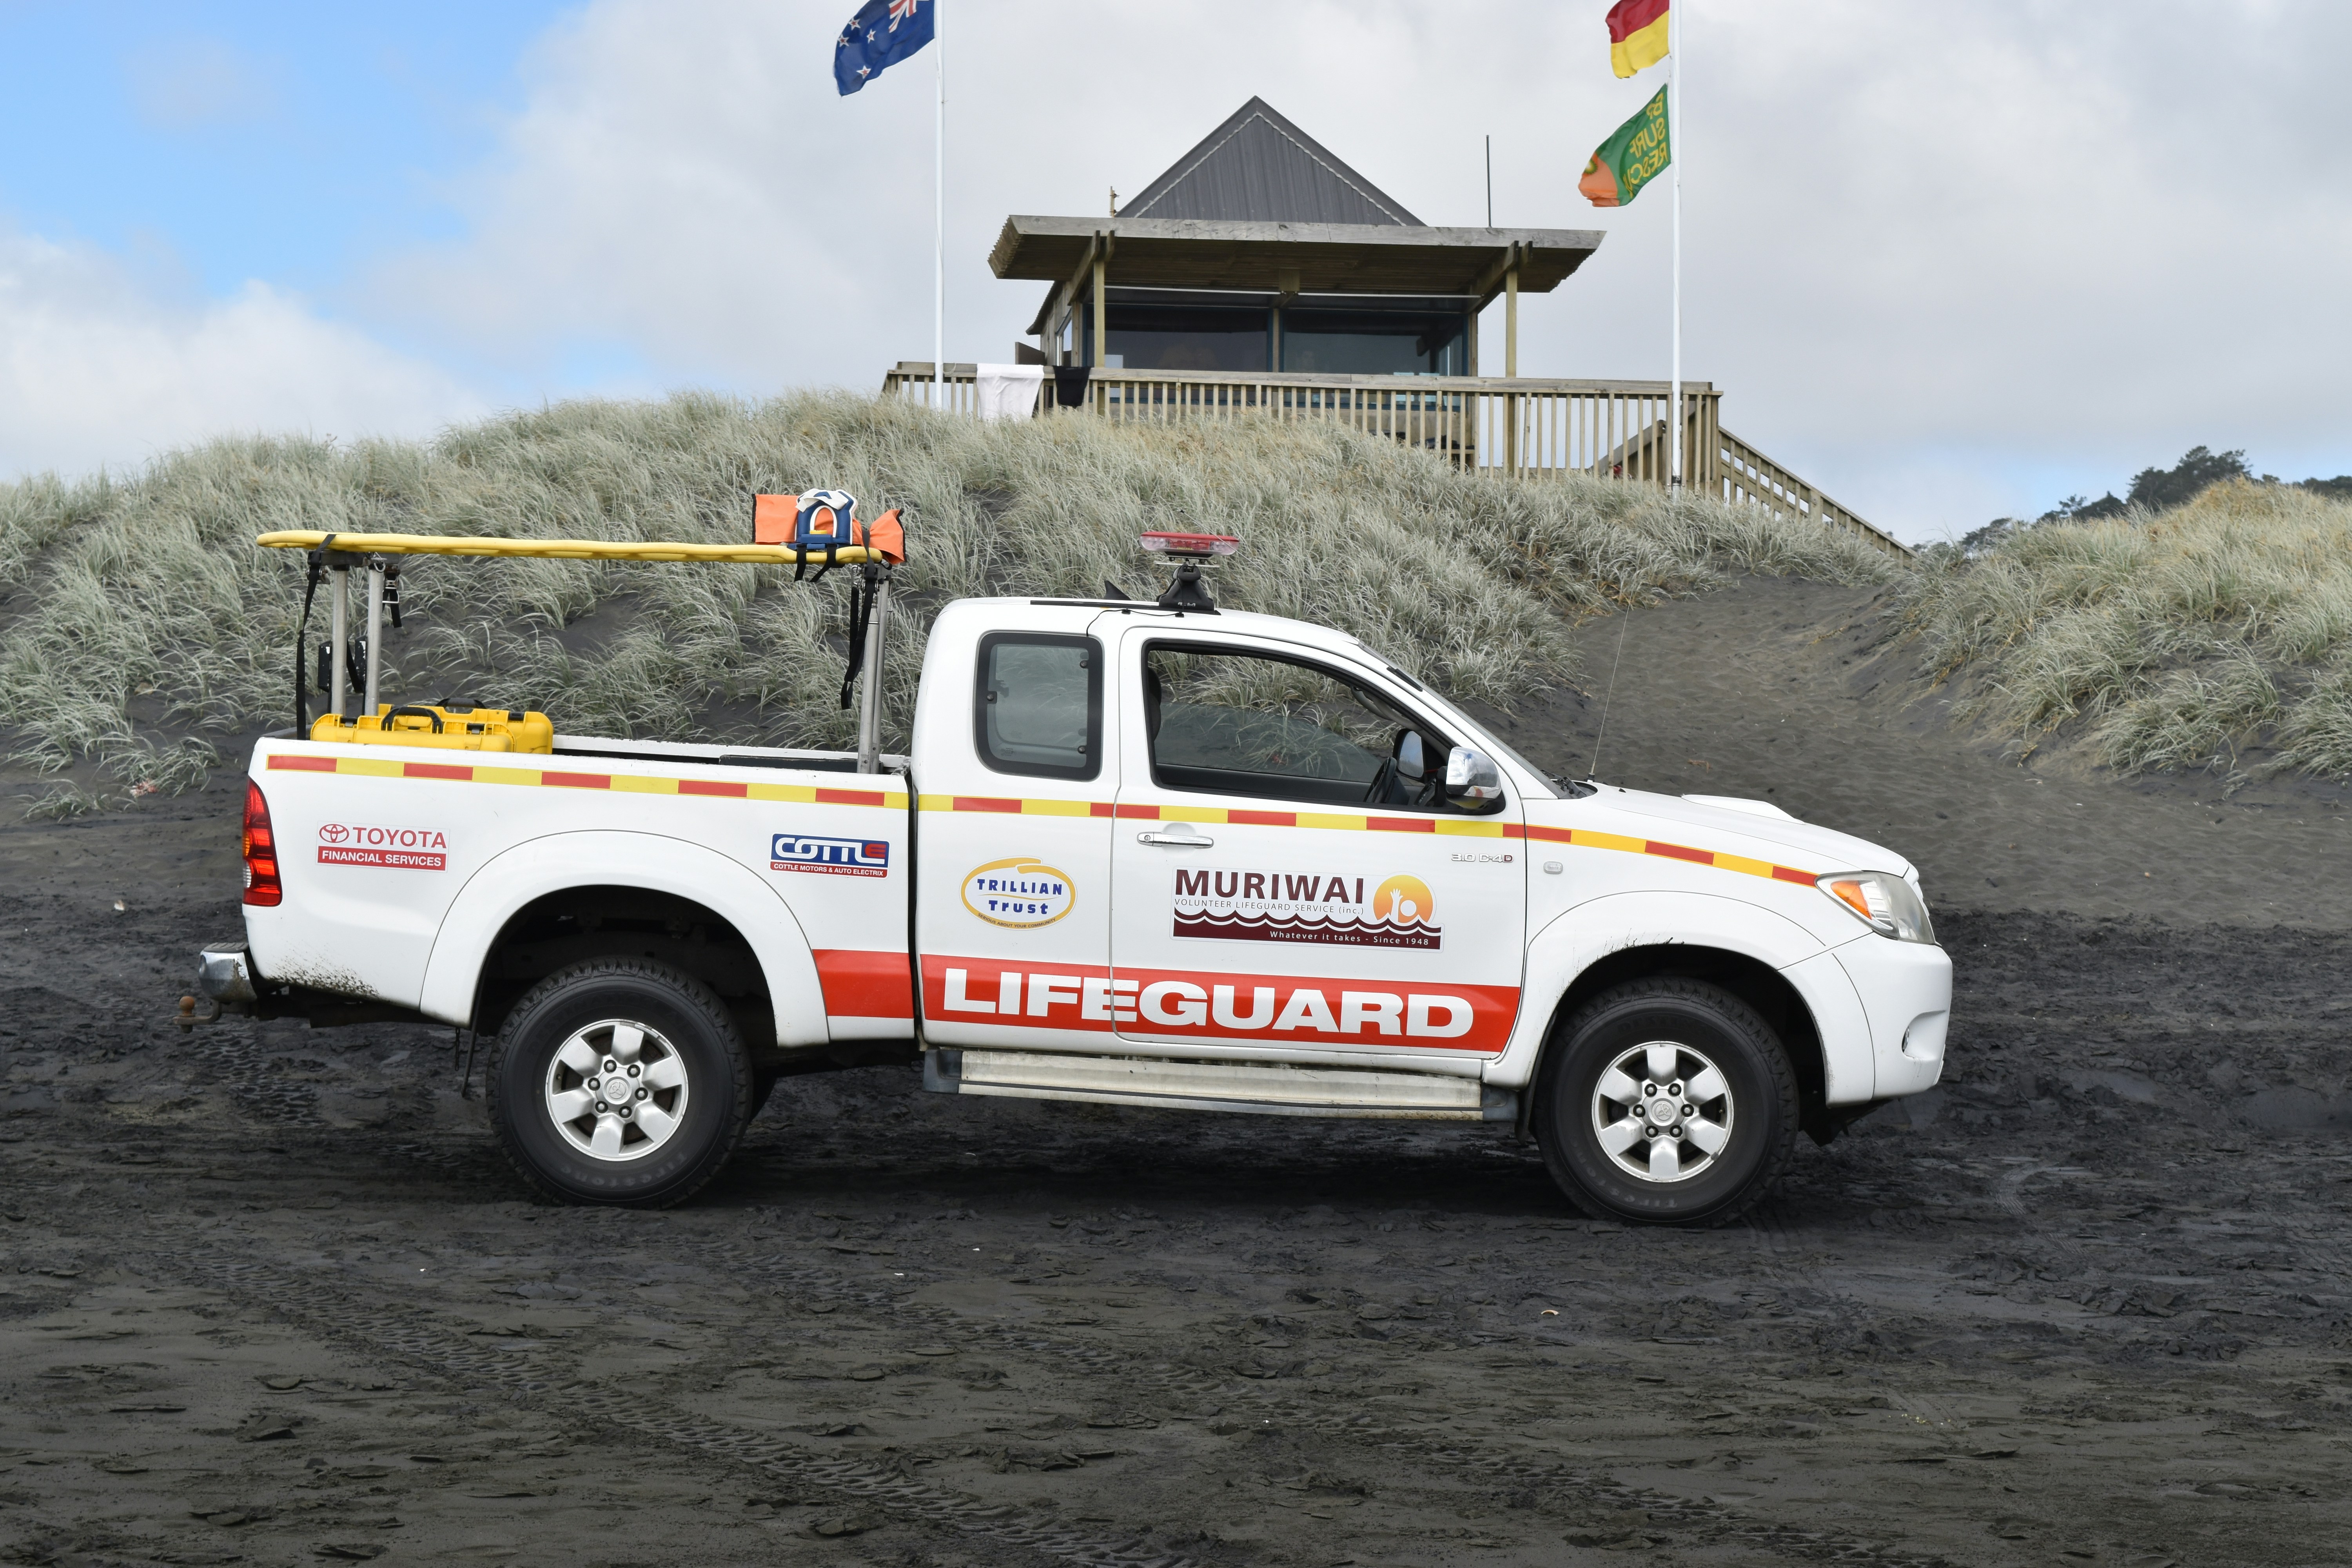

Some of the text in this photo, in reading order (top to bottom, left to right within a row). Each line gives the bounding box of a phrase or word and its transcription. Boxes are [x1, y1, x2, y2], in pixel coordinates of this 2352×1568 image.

[353, 827, 447, 849] TOYOTA
[322, 850, 441, 866] FINANCIAL SERVICES
[1452, 853, 1514, 863] 3.0 D-4D
[977, 878, 1062, 895] TRILLIAN
[1176, 869, 1364, 904] MURIWAI
[1174, 898, 1364, 915] VOLUNTEER LIFEGUARD SERVICE (inc.)
[978, 913, 996, 924] SERIOUS
[1028, 918, 1056, 928] COMMUNITY
[1270, 931, 1318, 940] Whatever
[1373, 936, 1400, 944] Since
[944, 968, 1474, 1038] LIFEGUARD
